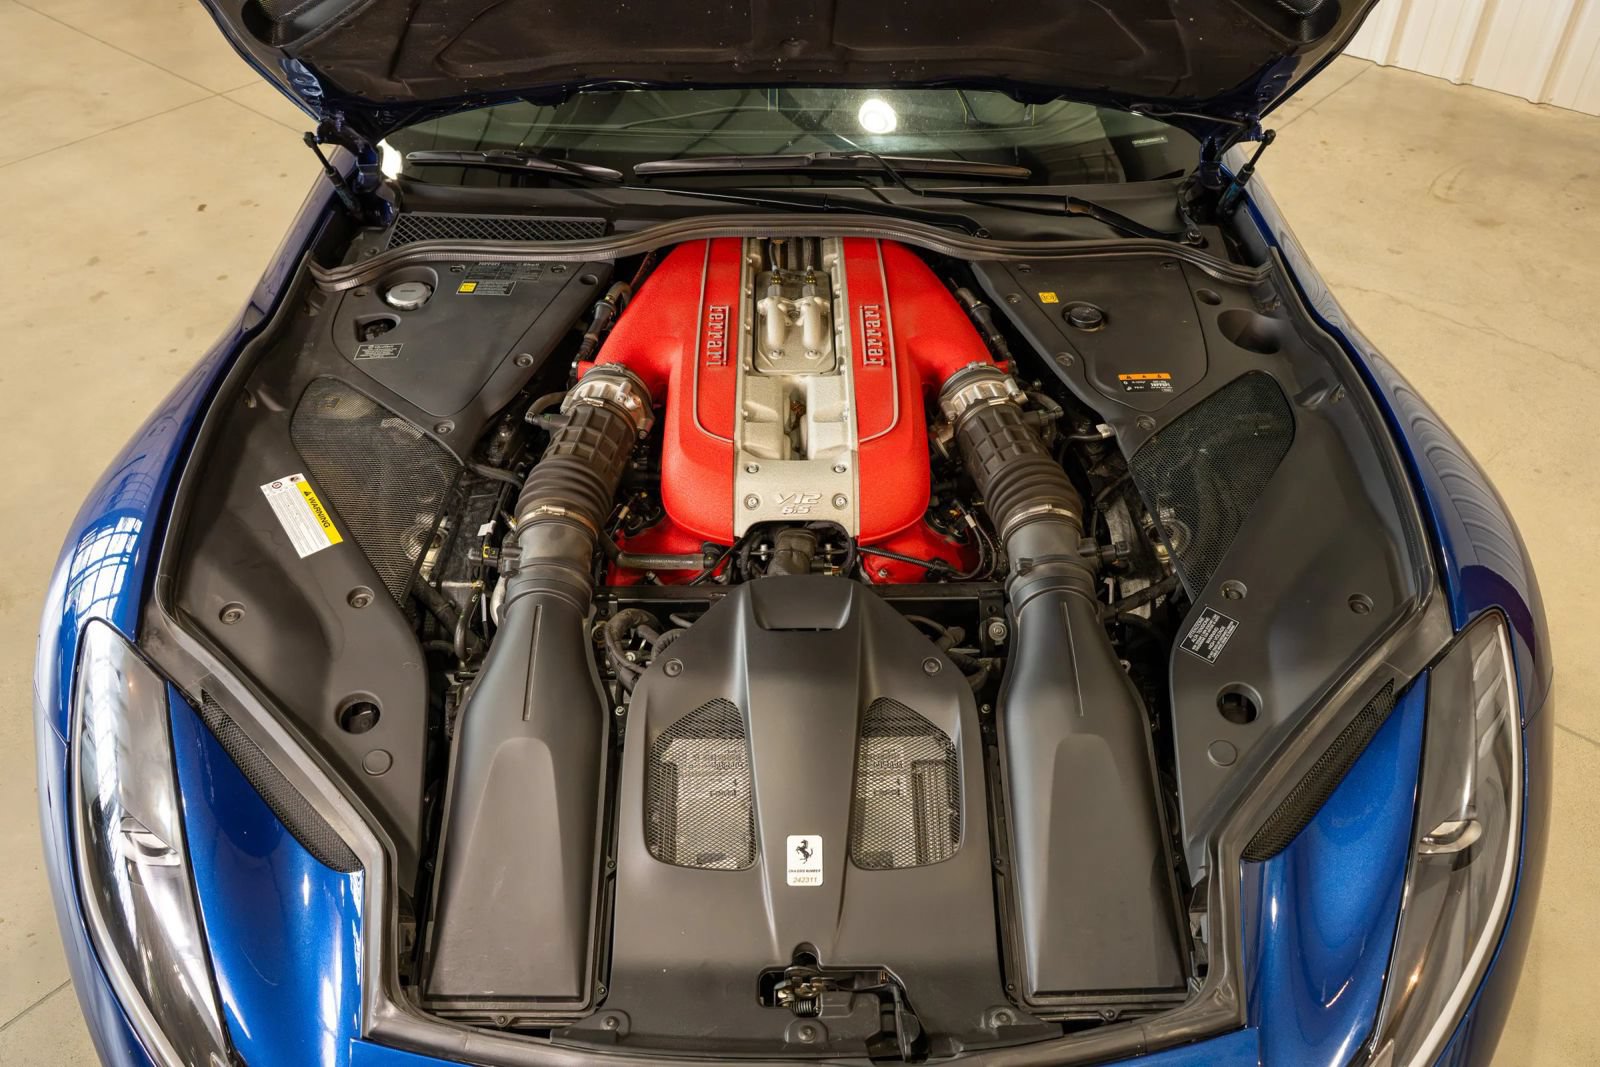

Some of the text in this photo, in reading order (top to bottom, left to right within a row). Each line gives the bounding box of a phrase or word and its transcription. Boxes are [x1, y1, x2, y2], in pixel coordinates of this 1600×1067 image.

[706, 304, 729, 367] Ferrari
[859, 304, 884, 367] Ferrari
[308, 496, 331, 529] WARNING
[776, 492, 823, 505] V12
